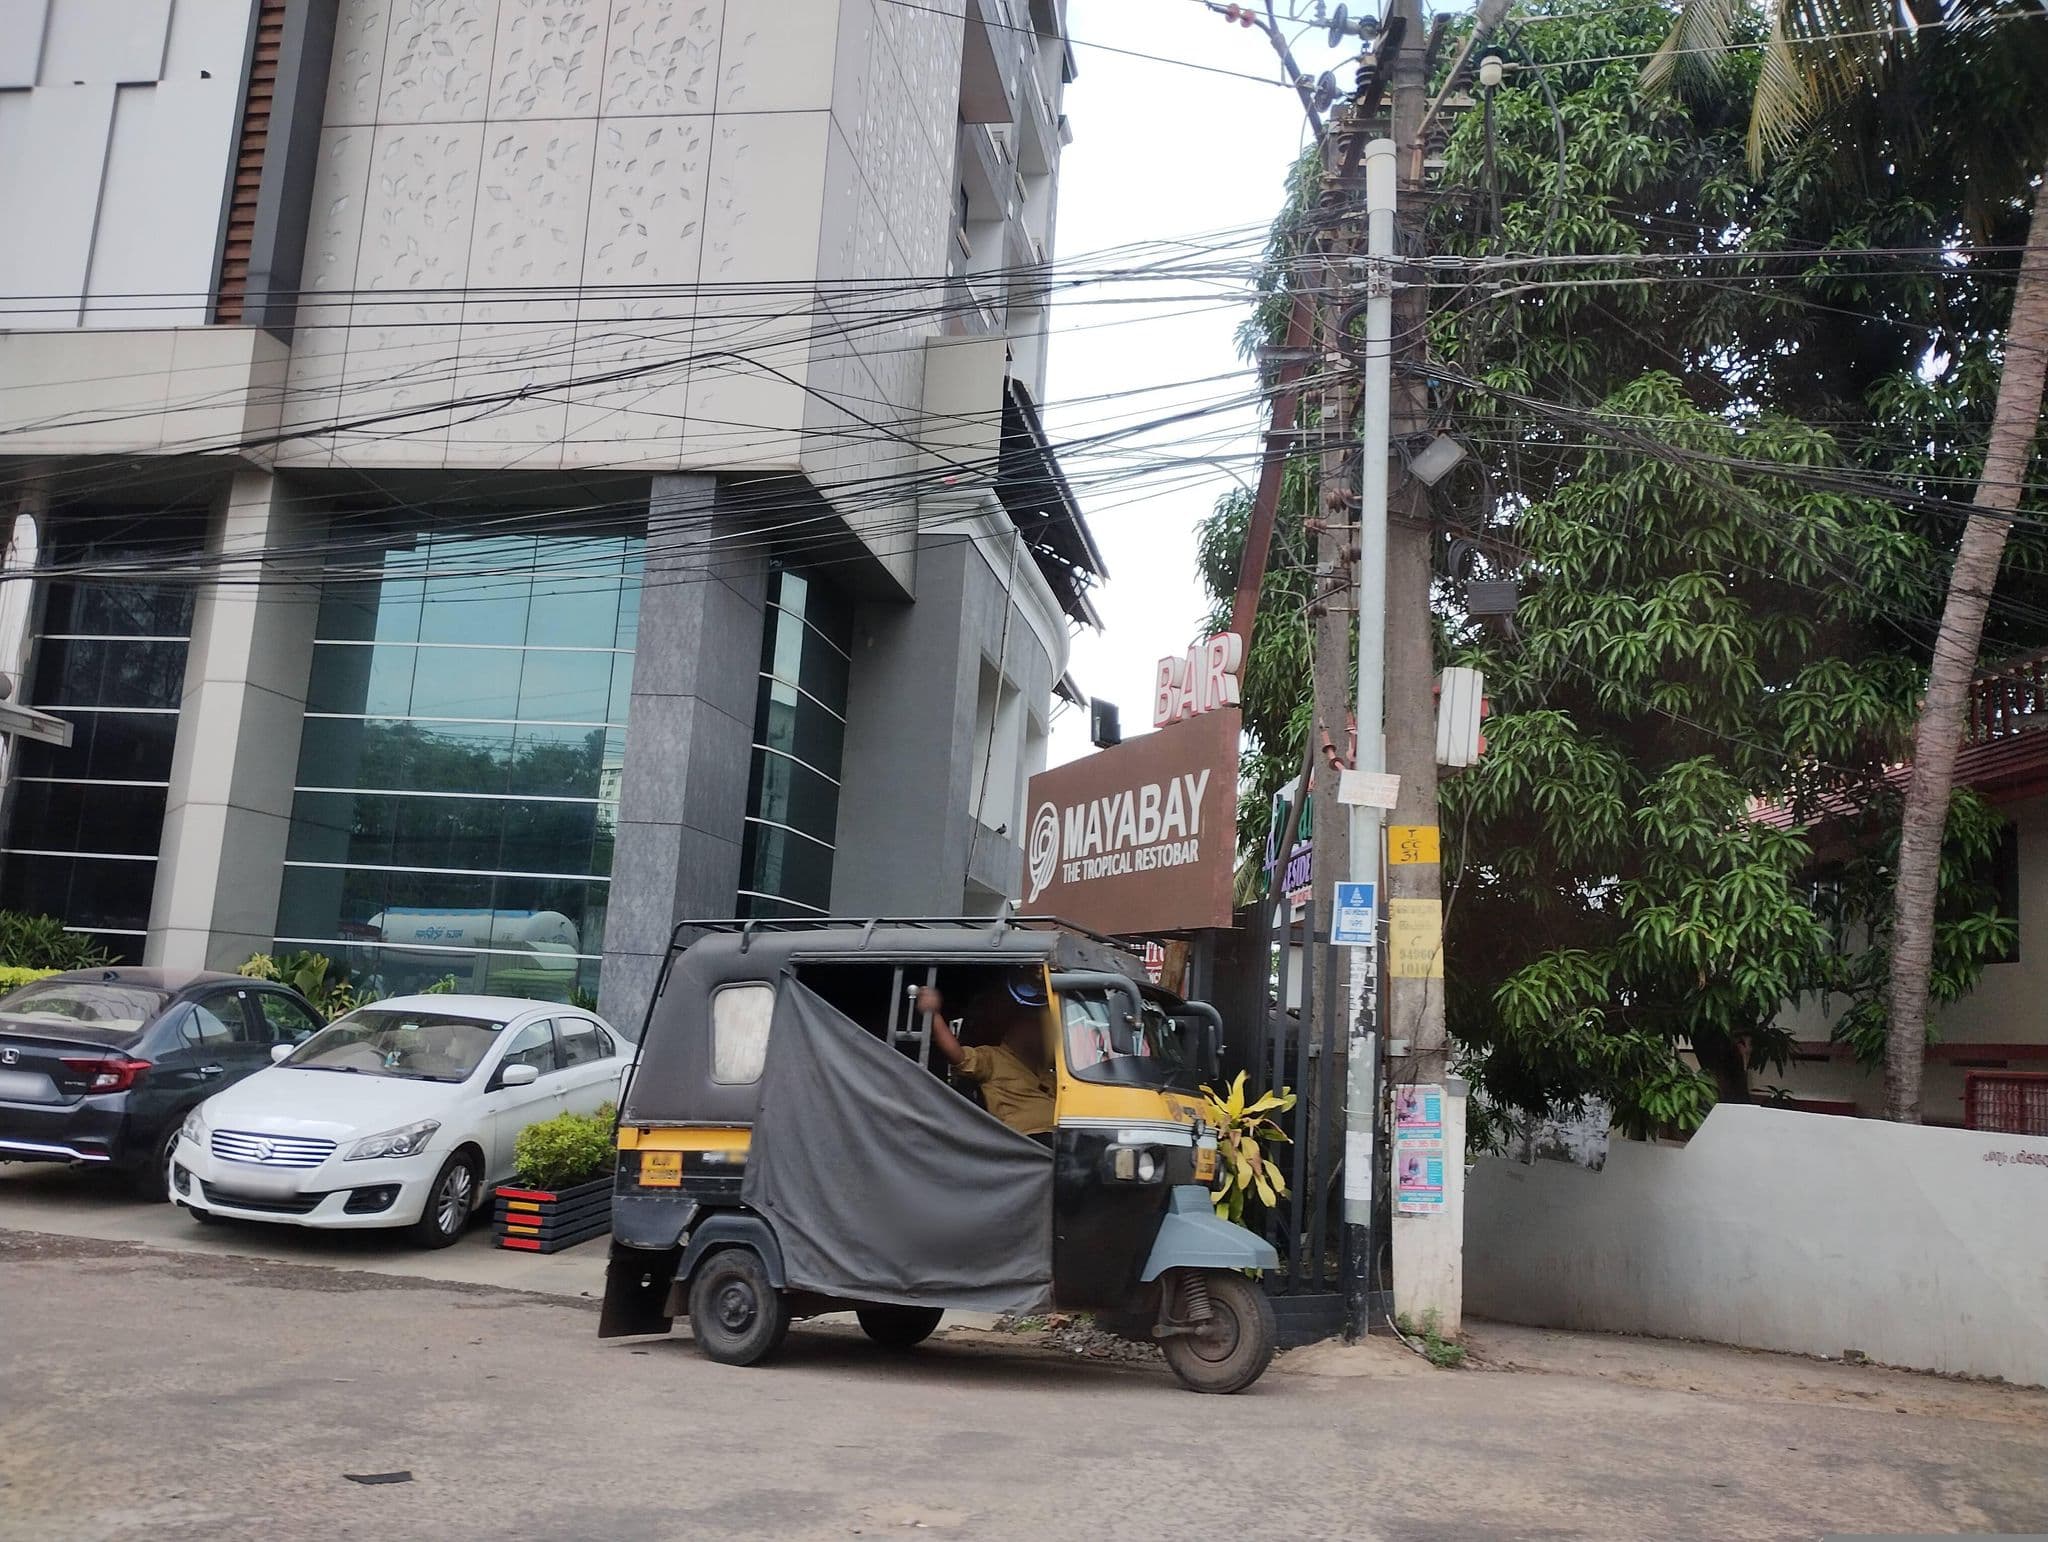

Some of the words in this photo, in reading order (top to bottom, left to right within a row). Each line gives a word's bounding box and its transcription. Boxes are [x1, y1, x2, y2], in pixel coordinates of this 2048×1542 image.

[1153, 631, 1242, 728] BAR
[1062, 768, 1211, 861] MAYABAY
[1062, 861, 1082, 884] THE
[1082, 851, 1133, 880] TROPICAL
[1134, 838, 1200, 872] RESTOBAR
